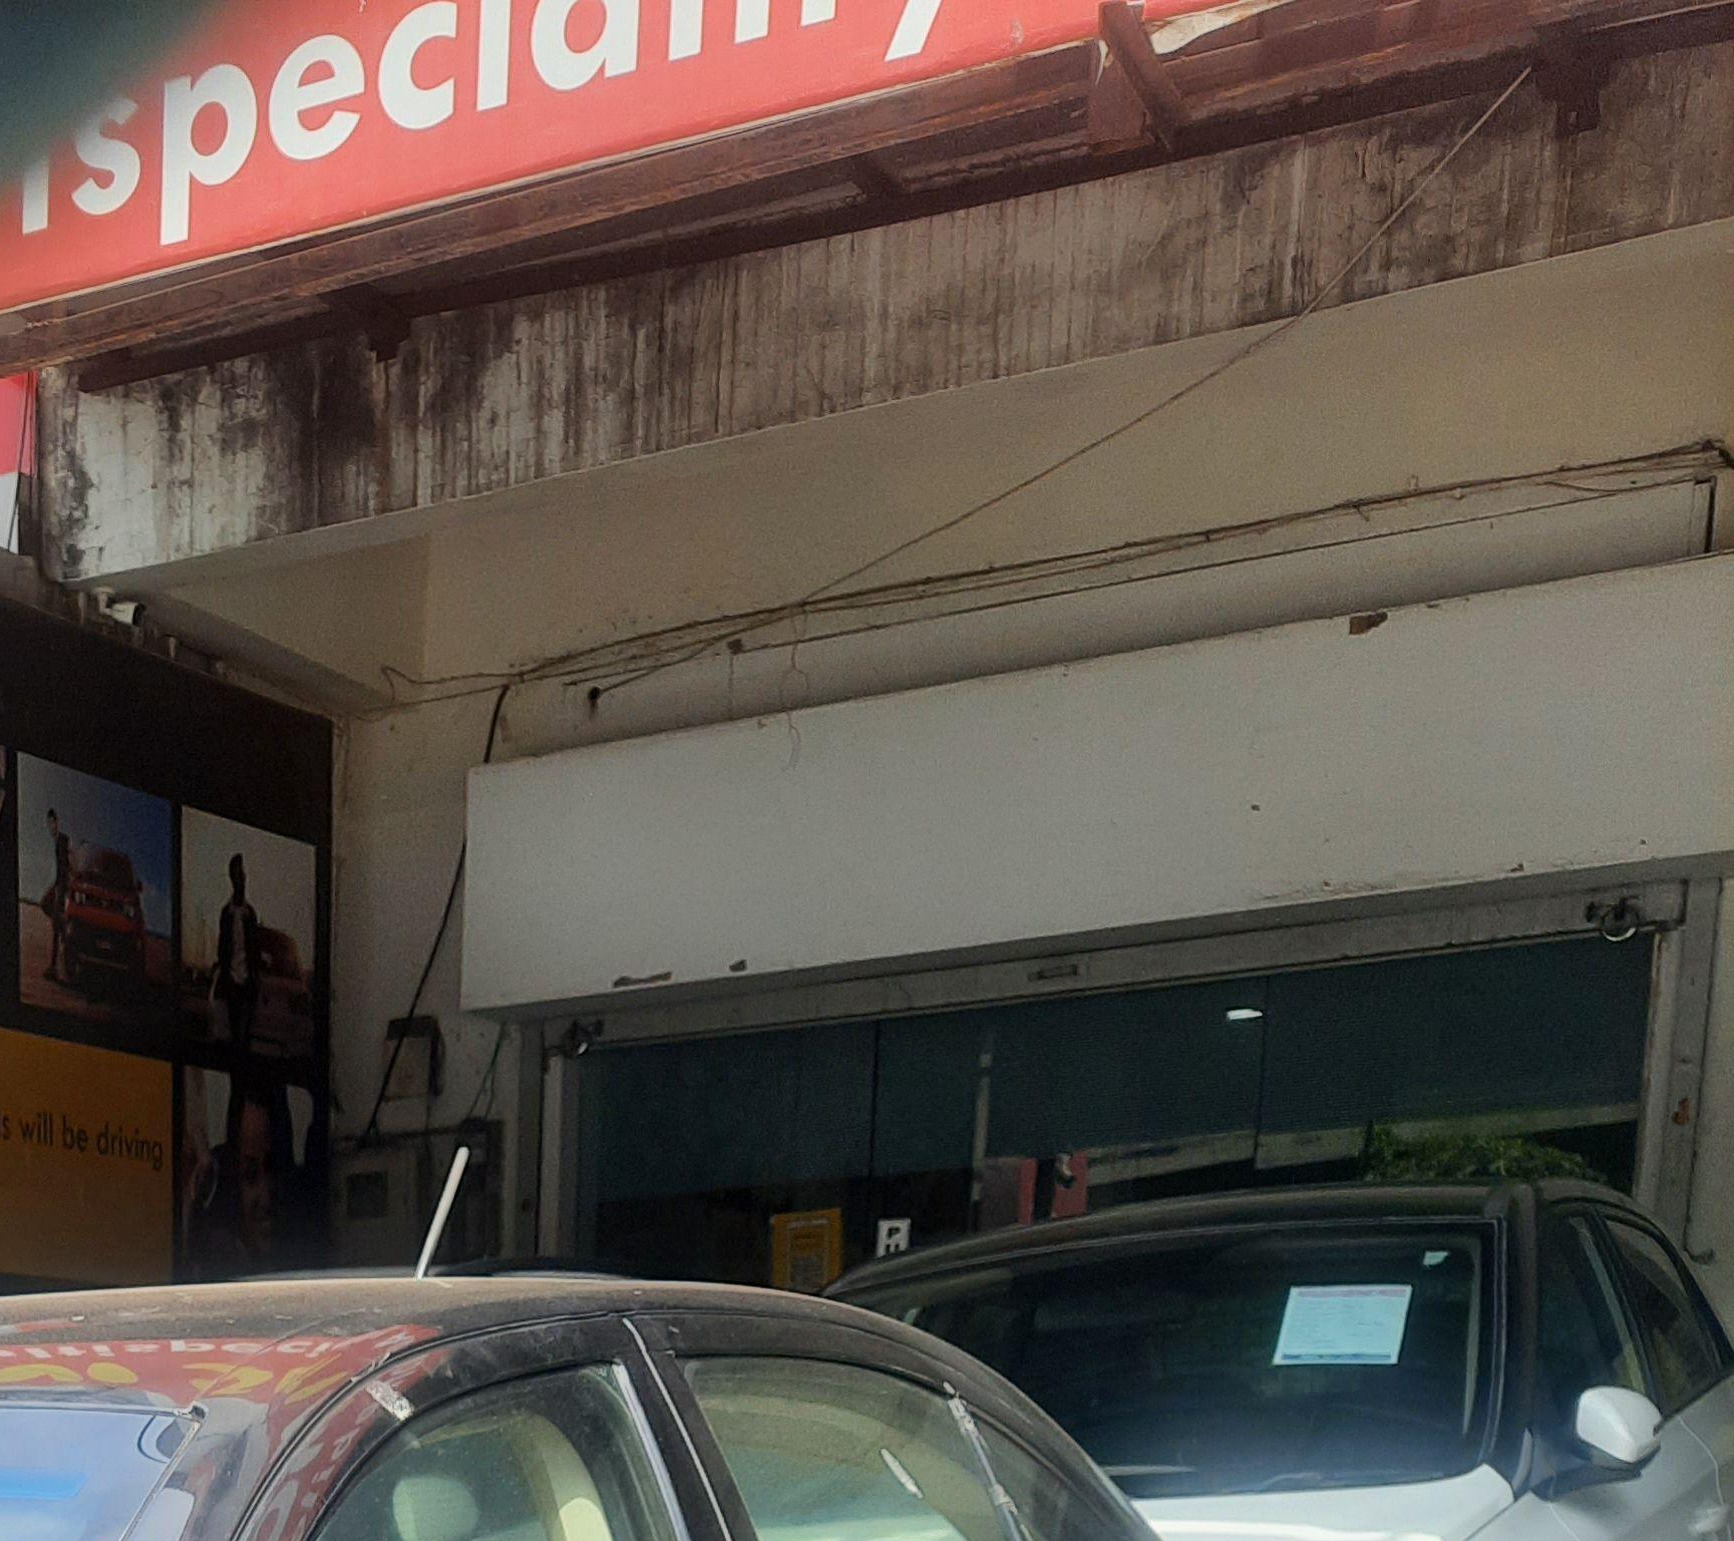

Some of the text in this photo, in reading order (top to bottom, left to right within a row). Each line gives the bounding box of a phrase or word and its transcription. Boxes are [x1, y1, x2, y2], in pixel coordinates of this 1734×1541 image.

[20, 1111, 54, 1147] will
[62, 1115, 89, 1151] be
[97, 1121, 164, 1172] driving
